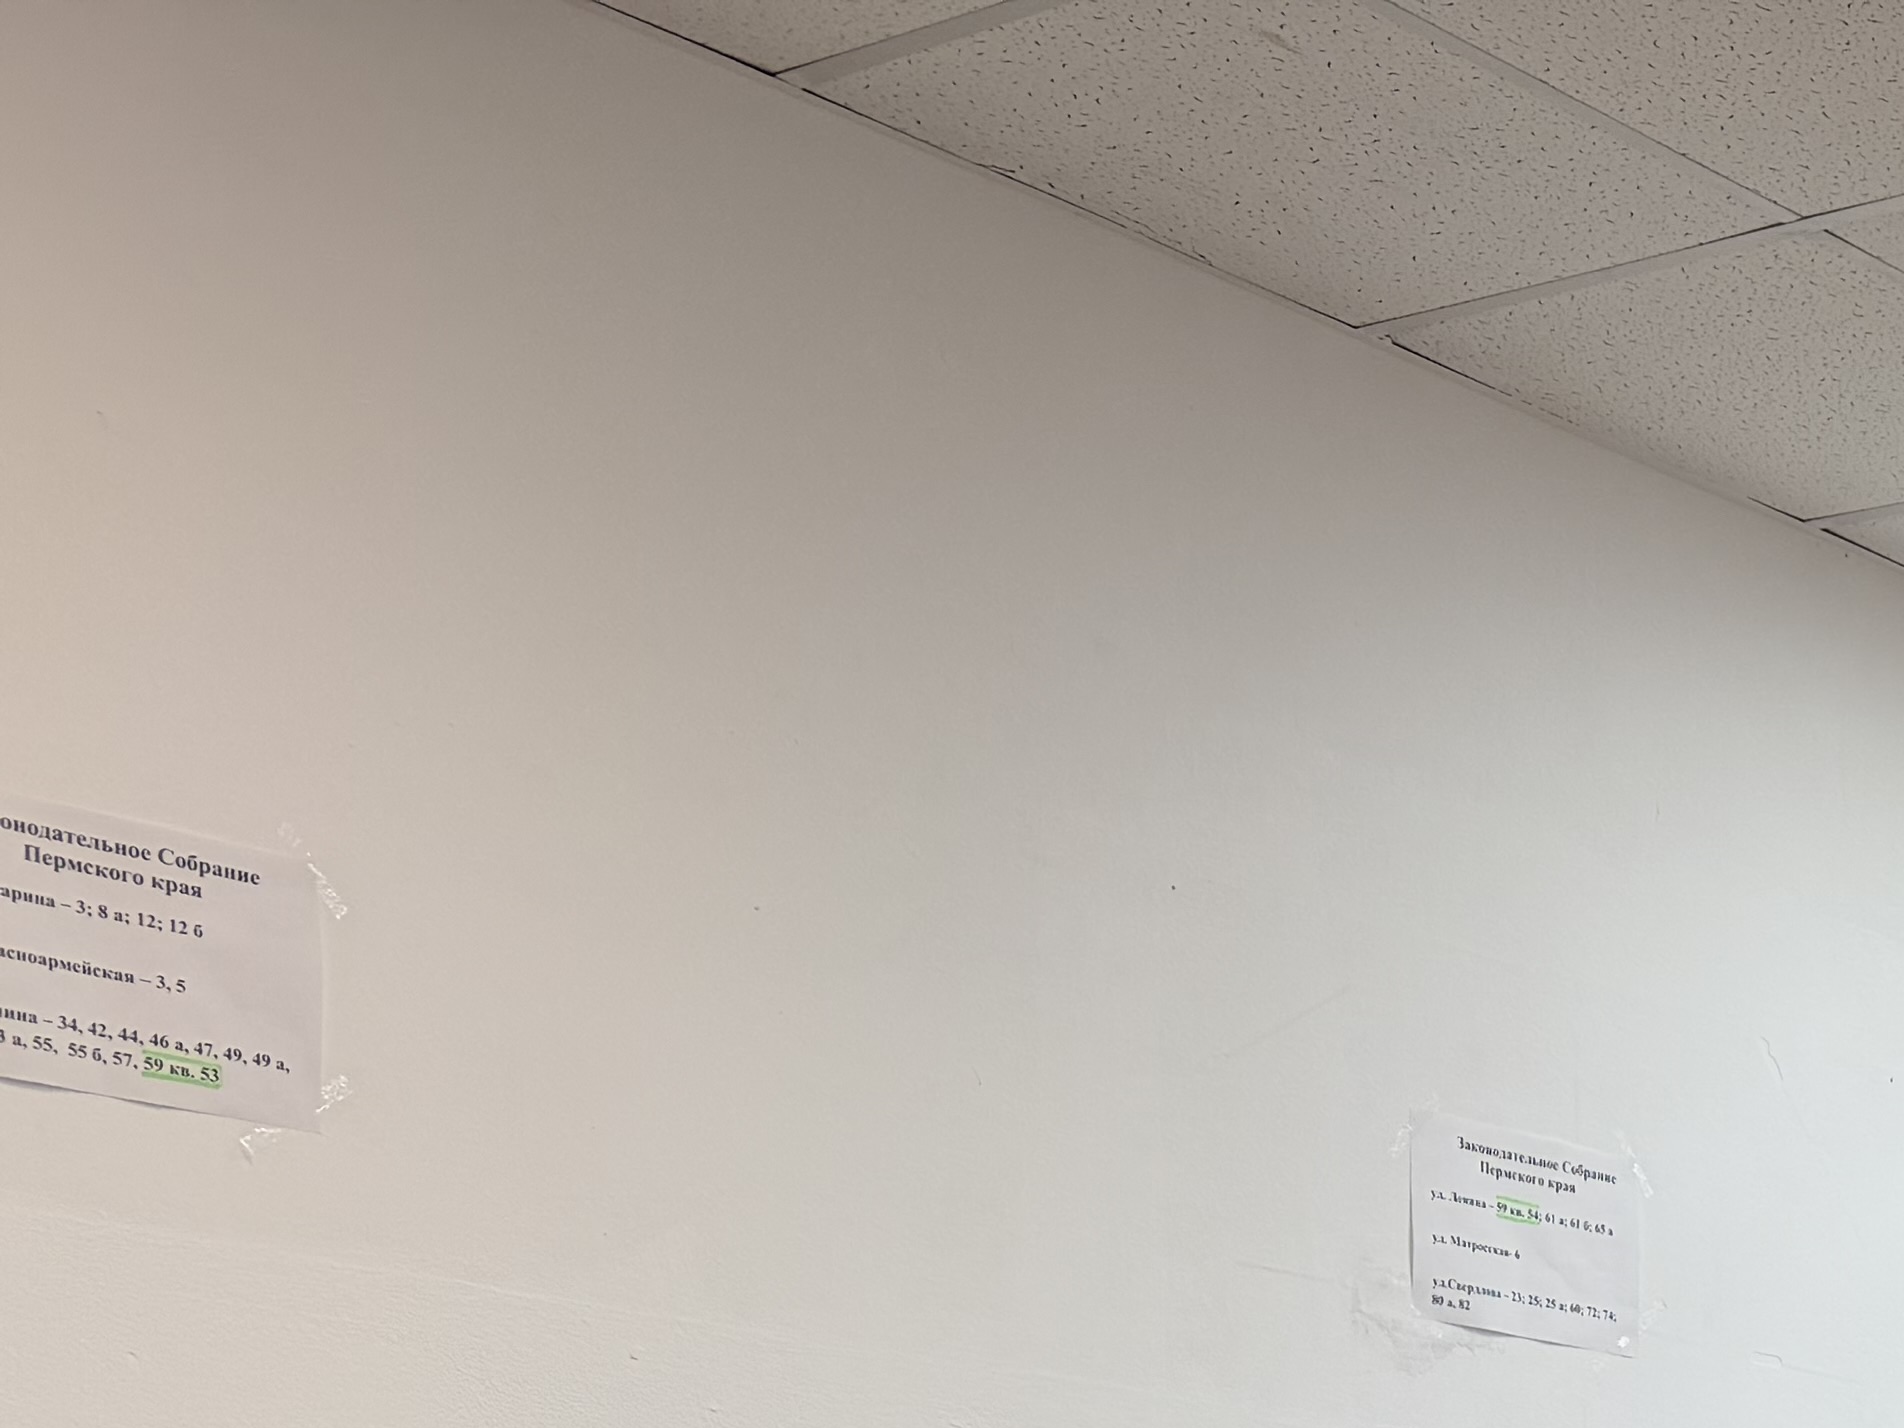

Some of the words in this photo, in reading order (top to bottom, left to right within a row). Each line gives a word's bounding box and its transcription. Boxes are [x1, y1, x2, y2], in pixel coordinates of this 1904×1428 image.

[24, 844, 144, 886] Пермского
[151, 876, 203, 899] края
[158, 847, 261, 886] Собрание
[76, 900, 93, 918] 3;
[98, 905, 108, 919] 8
[114, 911, 131, 925] а;
[138, 913, 164, 932] 12;
[170, 920, 188, 936] 12
[156, 975, 172, 993] 3,
[176, 979, 187, 993] 5
[12, 1036, 28, 1049] а,
[32, 1036, 58, 1054] 55,
[68, 1043, 87, 1059] 55
[112, 1052, 138, 1070] 57,
[144, 1056, 164, 1073] 59
[170, 1063, 195, 1079] кв.
[200, 1067, 220, 1083] 53
[57, 1015, 83, 1035] 34,
[88, 1023, 113, 1041] 42,
[118, 1028, 144, 1047] 44,
[149, 1033, 169, 1049] 46
[175, 1040, 189, 1055] а,
[194, 1043, 219, 1060] 47,
[223, 1048, 248, 1066] 49,
[252, 1052, 271, 1068] 49
[276, 1060, 290, 1074] а,
[1457, 1136, 1559, 1170] Законодательное
[1562, 1160, 1617, 1184] Собрание
[1480, 1160, 1544, 1186] Пермского
[1548, 1179, 1576, 1194] края
